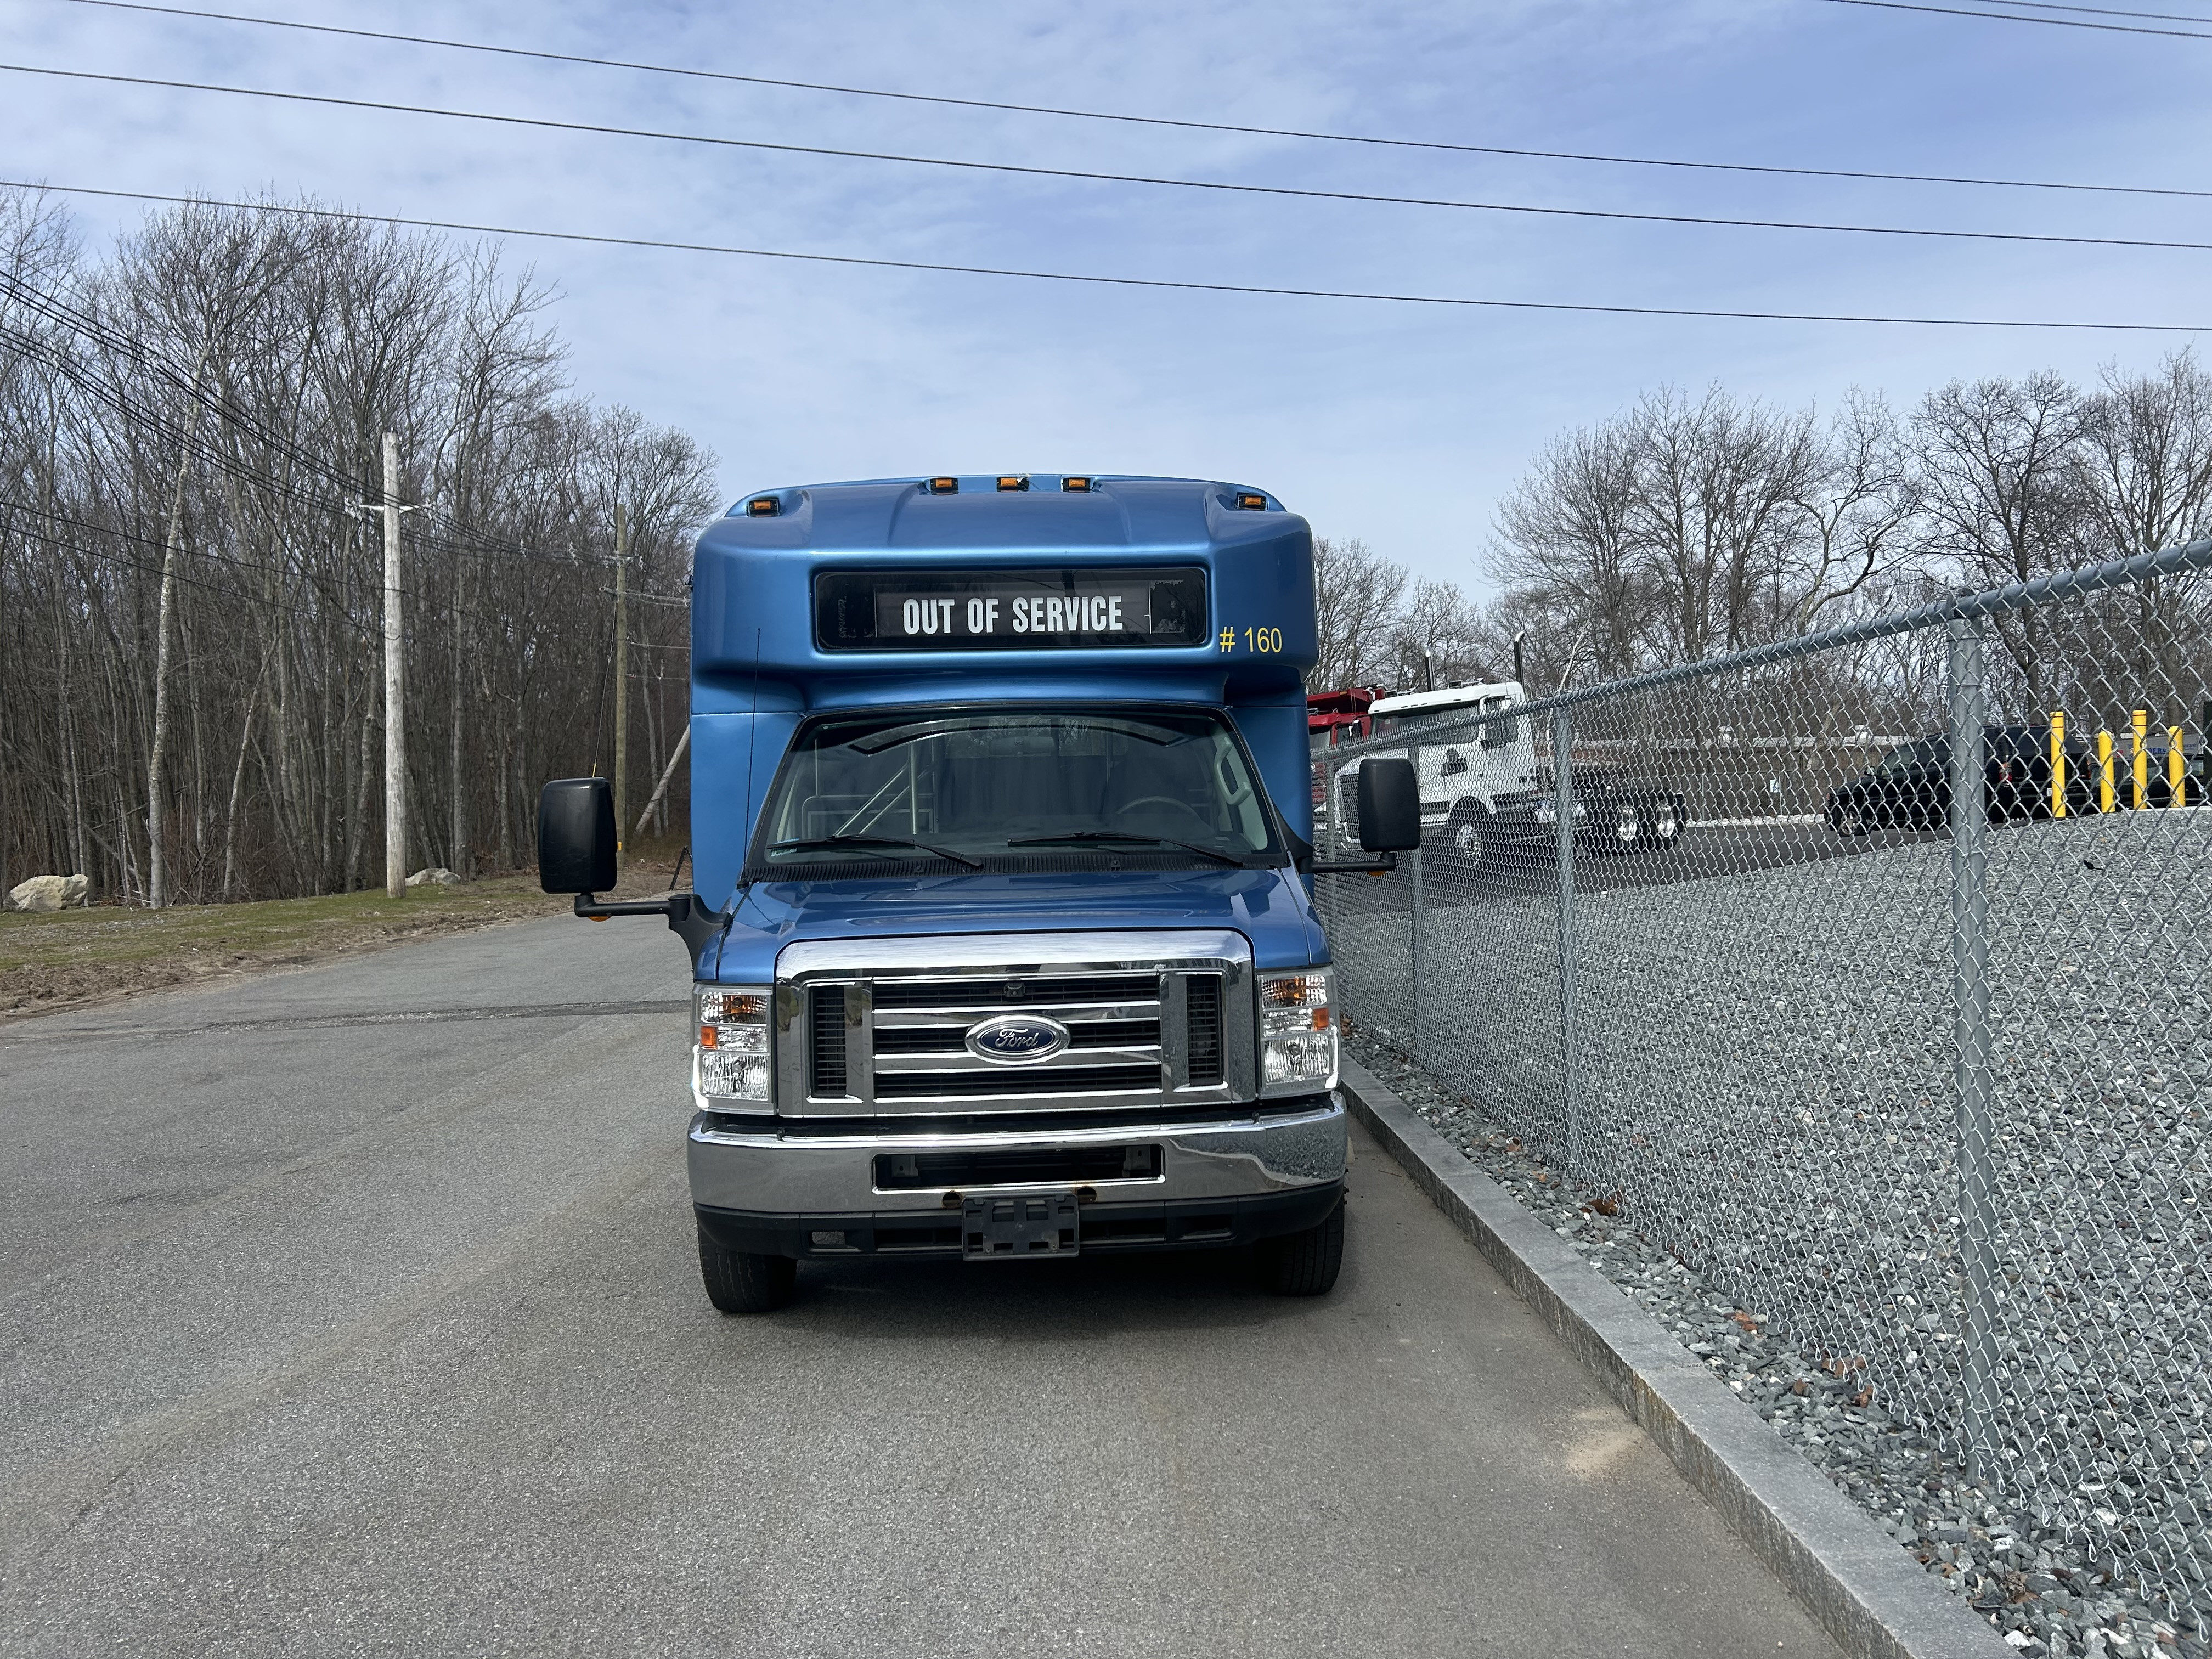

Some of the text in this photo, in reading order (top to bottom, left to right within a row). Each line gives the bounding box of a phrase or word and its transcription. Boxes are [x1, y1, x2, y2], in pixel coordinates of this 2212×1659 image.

[903, 596, 1124, 634] OUT OF SERVICE
[1219, 626, 1282, 653] # 160
[995, 1028, 1039, 1048] Ford
